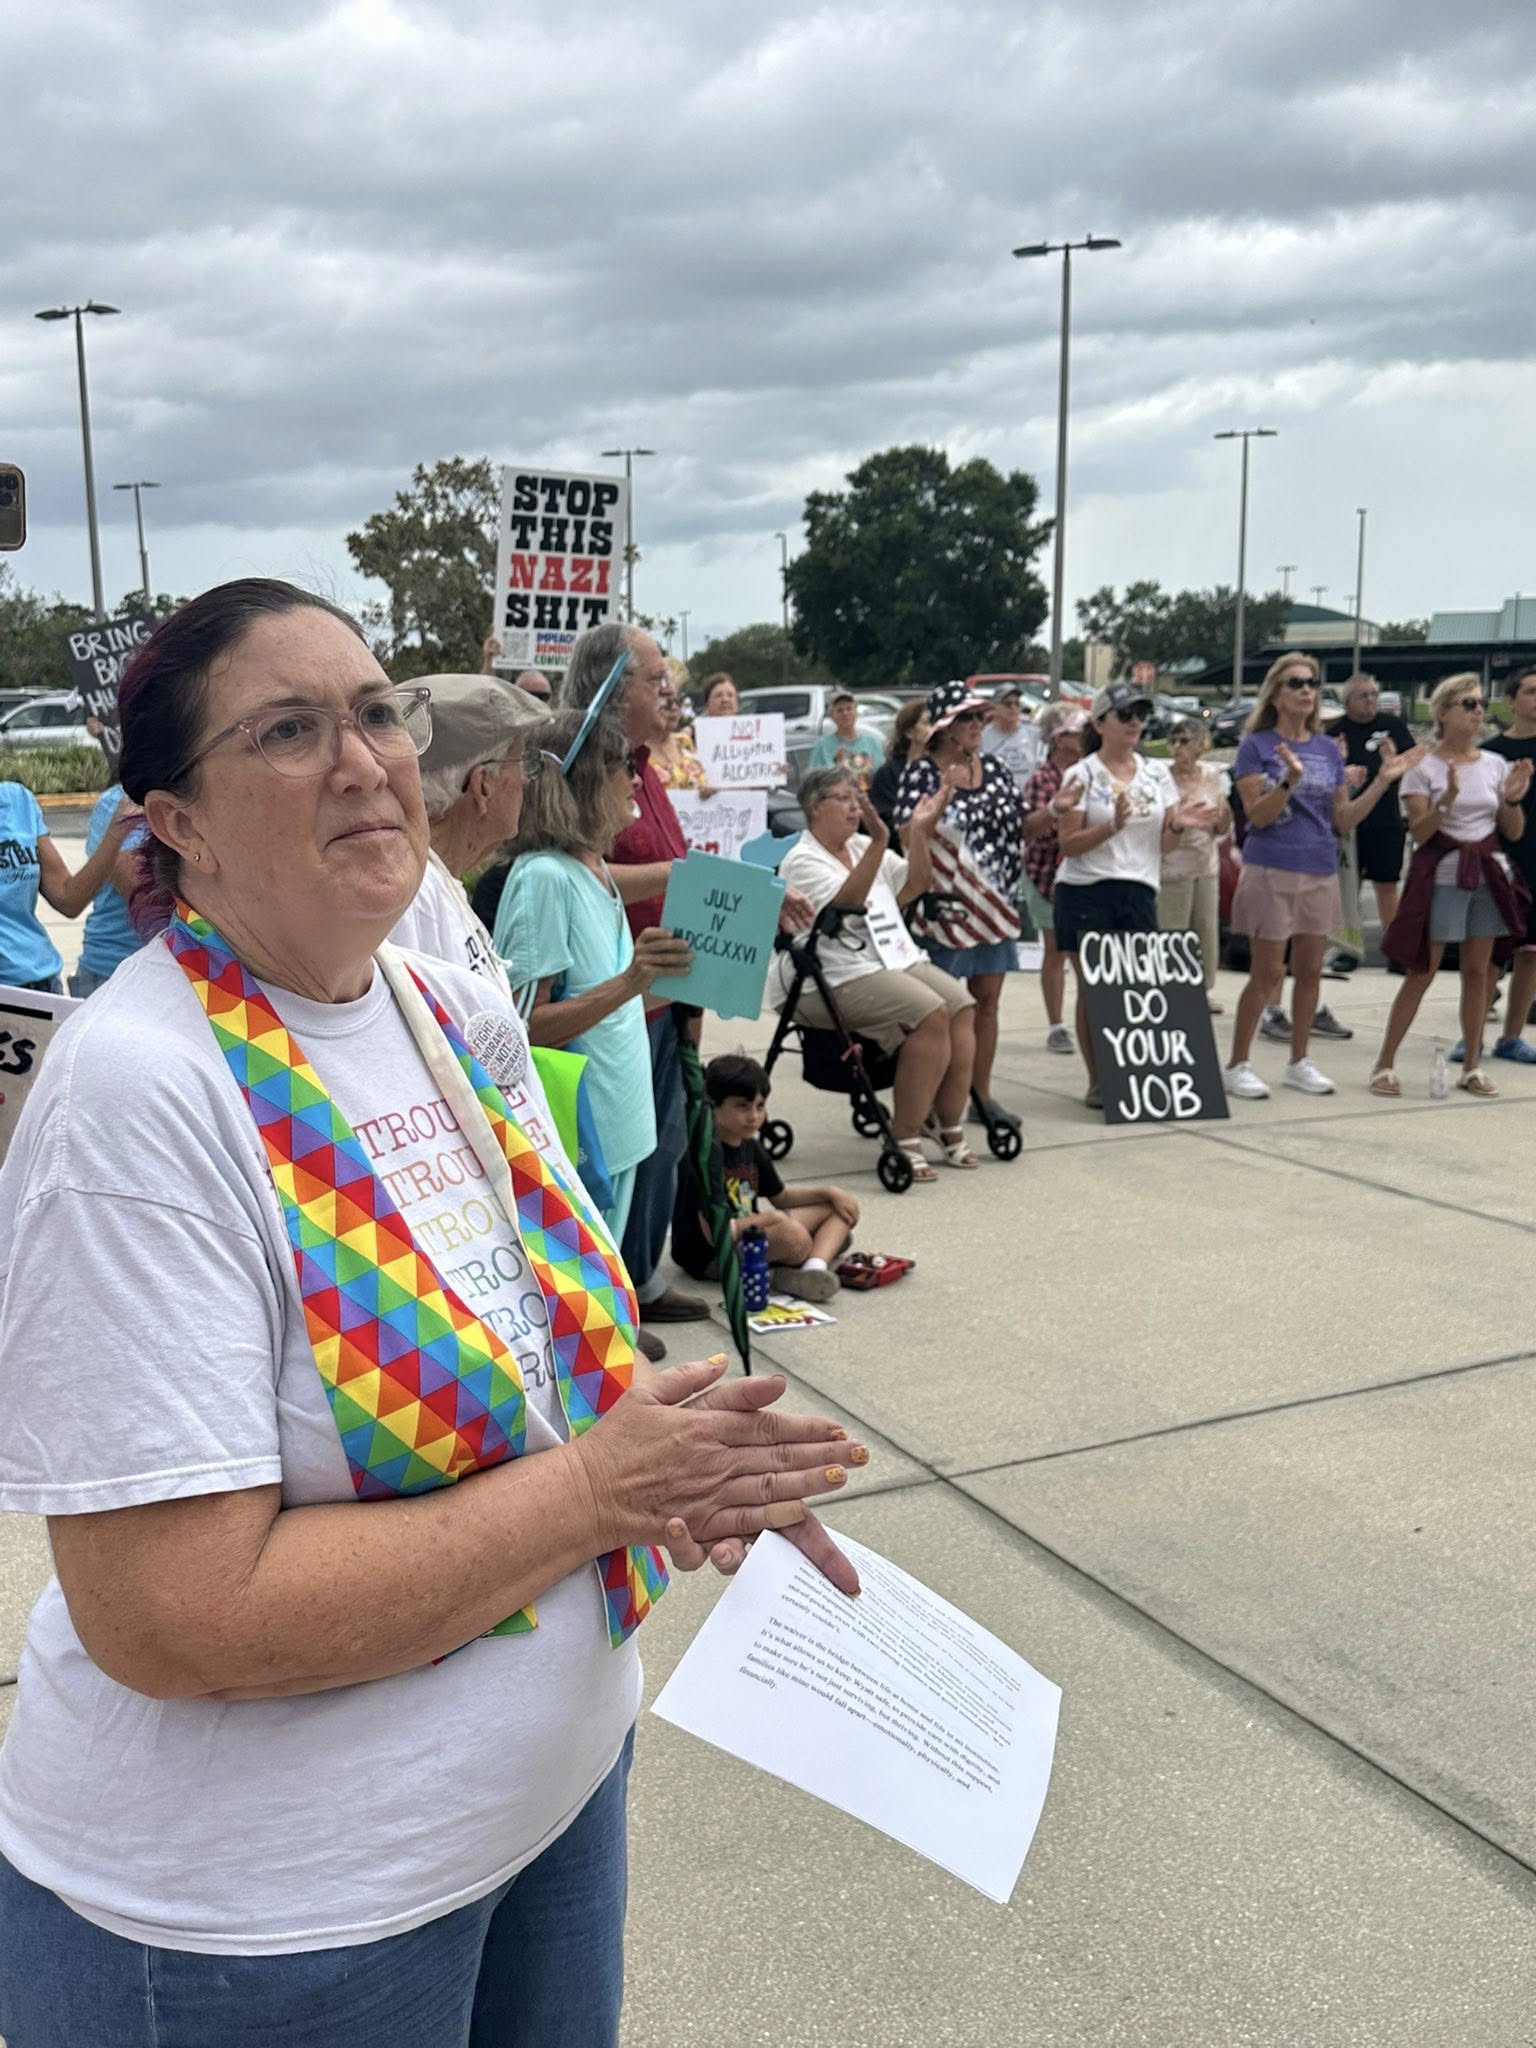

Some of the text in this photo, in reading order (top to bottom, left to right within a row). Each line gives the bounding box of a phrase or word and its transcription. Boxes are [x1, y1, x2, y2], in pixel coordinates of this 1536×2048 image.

[513, 475, 619, 517] STOP
[511, 514, 613, 556] THIS
[509, 553, 611, 594] NAZI
[505, 593, 609, 630] SHIT
[69, 620, 153, 660] BRING
[704, 889, 743, 913] JULY
[710, 913, 726, 932] IV
[1123, 988, 1168, 1024] DO
[473, 1020, 495, 1049] FIGHT
[479, 1021, 510, 1066] GNORANCE
[1102, 1027, 1195, 1068] YOUR
[495, 1042, 513, 1065] NOT
[497, 1041, 525, 1083] IMMIGRANTS
[1118, 1072, 1202, 1120] JOB
[769, 1616, 782, 1629] The
[782, 1594, 811, 1614] certainly
[760, 1628, 774, 1640] It's
